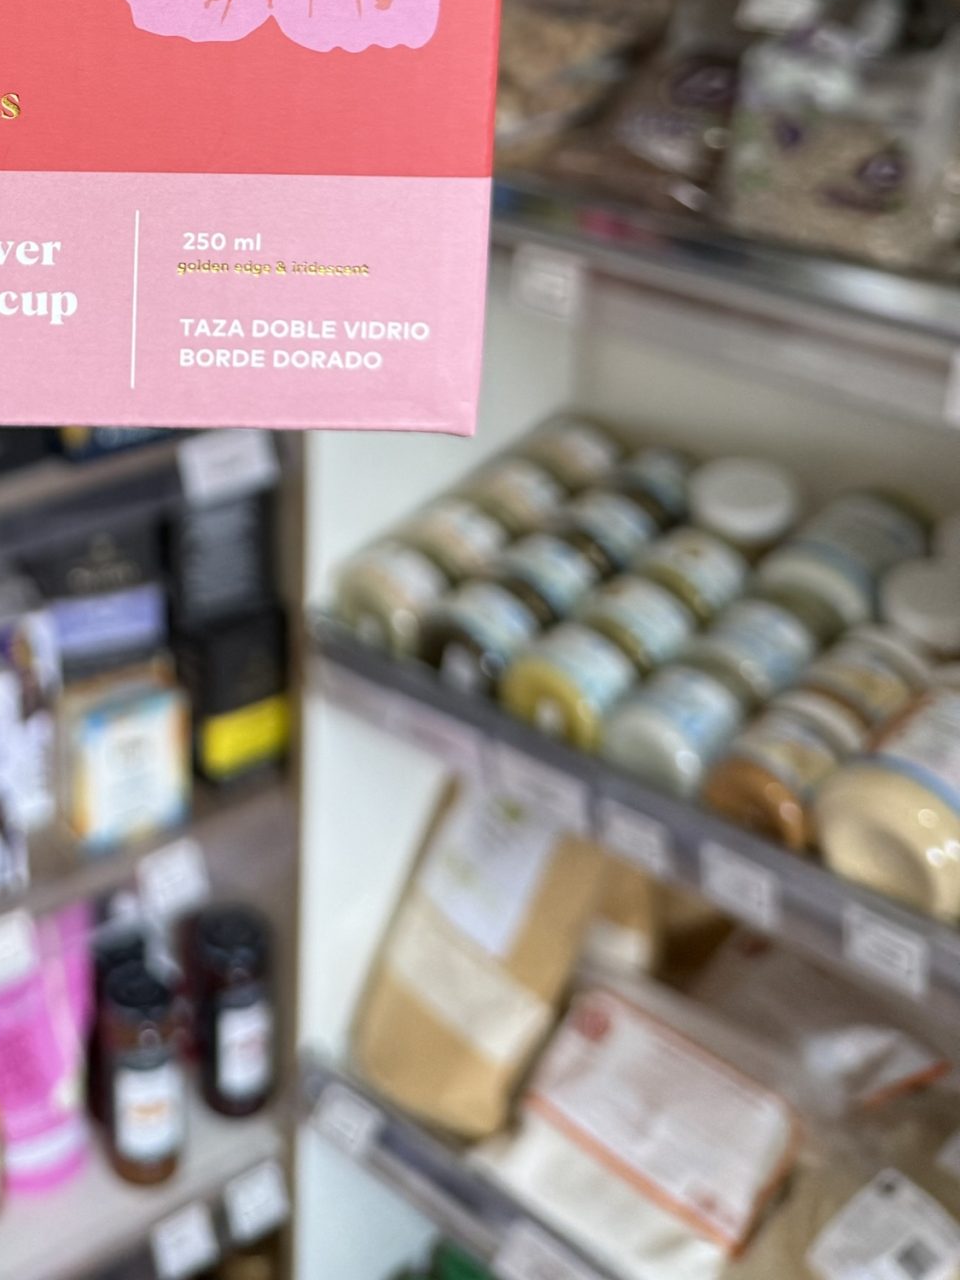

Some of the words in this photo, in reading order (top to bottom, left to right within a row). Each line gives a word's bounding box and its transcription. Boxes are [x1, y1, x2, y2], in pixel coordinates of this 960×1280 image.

[182, 231, 226, 251] 250
[234, 232, 262, 252] ml
[176, 259, 230, 277] golden
[233, 261, 272, 278] edge
[274, 261, 288, 276] &
[290, 260, 370, 278] iridescent
[180, 319, 244, 338] TAZA
[252, 320, 336, 340] DOBLE
[344, 321, 430, 341] VIDRIO
[179, 349, 265, 368] BORDE
[273, 350, 383, 370] DORADO
